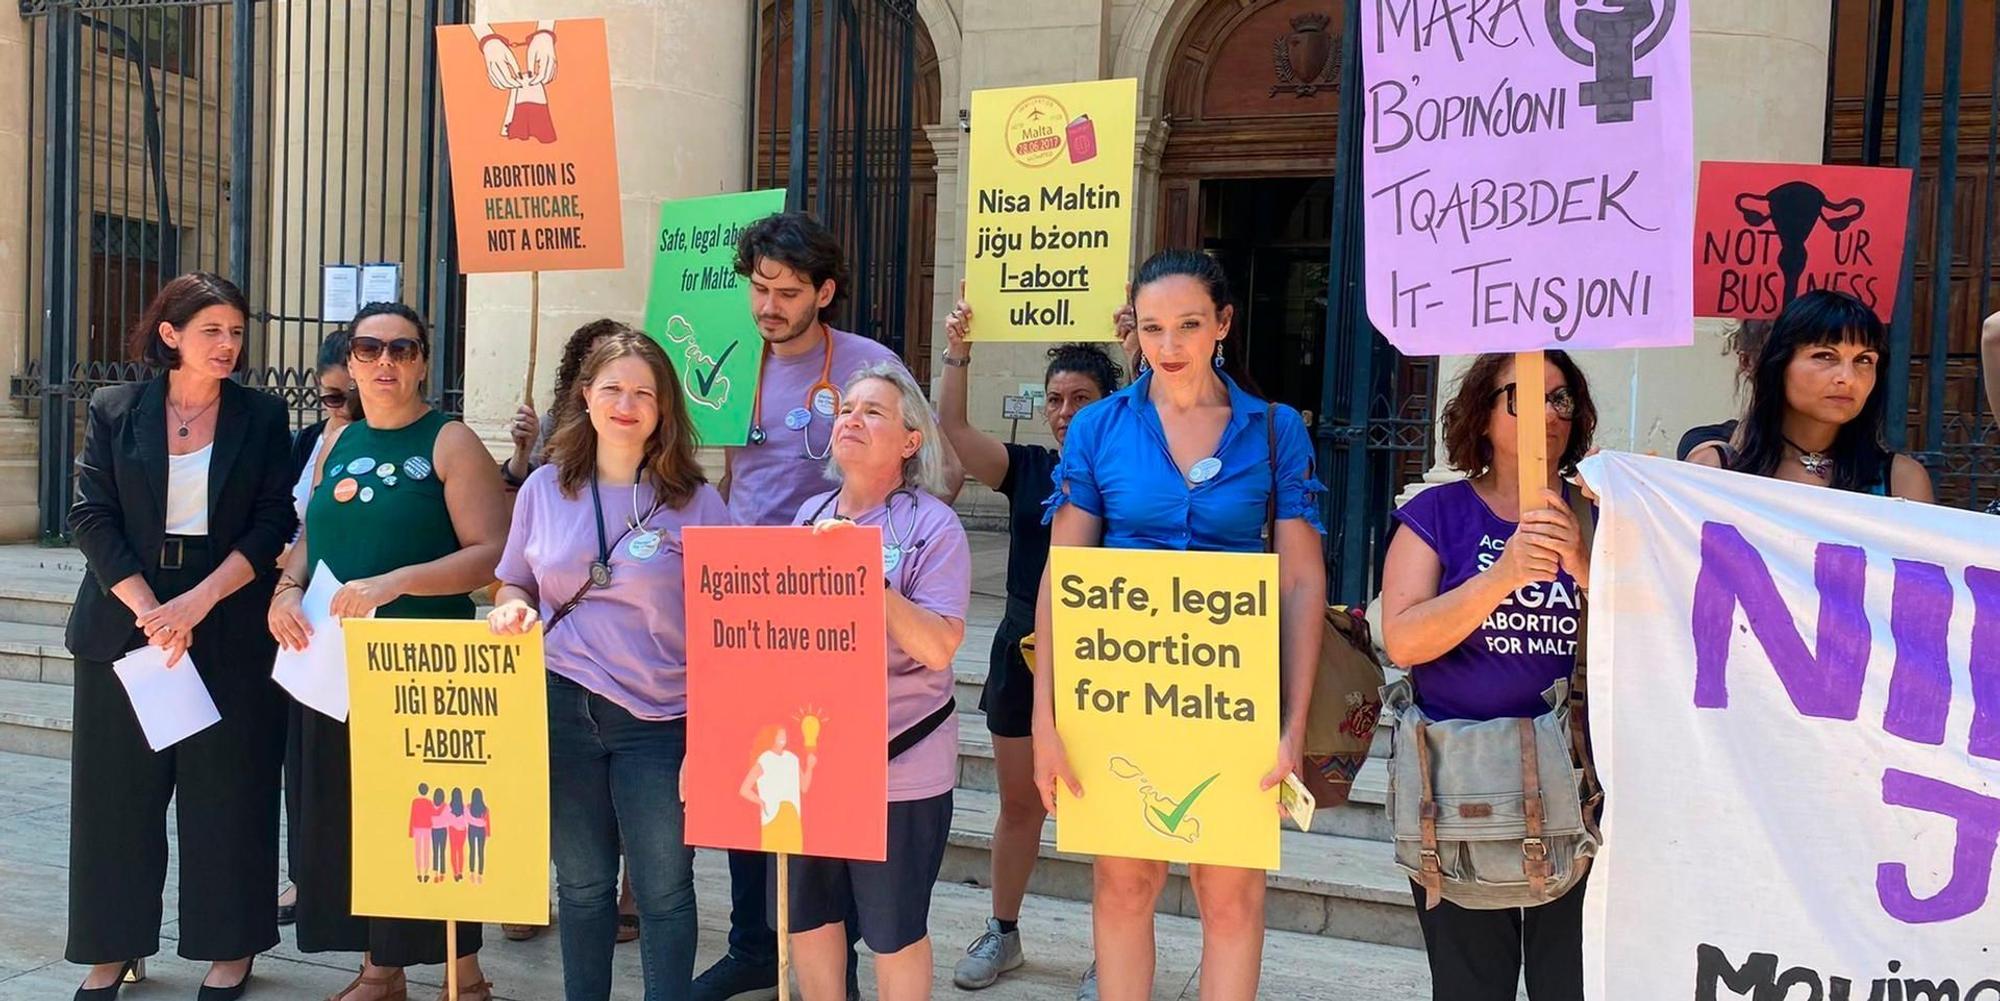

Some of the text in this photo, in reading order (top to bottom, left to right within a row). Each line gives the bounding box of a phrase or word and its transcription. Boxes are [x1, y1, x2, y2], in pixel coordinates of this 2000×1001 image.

[1022, 125, 1054, 140] Malta
[483, 162, 576, 188] ABORTION IS
[485, 195, 584, 220] HEALTHCARE,
[979, 183, 1120, 214] Nisa Maltin
[1371, 169, 1661, 244] TQABBDEK
[487, 226, 587, 252] NOT A CRIME.
[660, 227, 688, 253] Safe,
[691, 223, 722, 255] legal
[975, 225, 1109, 258] jiġu bżonn
[1704, 229, 1873, 266] NOT UR
[681, 265, 738, 291] for Malta.
[1000, 262, 1089, 290] l-abort
[1010, 299, 1075, 326] ukoll.
[700, 565, 867, 601] Against abortion?
[1061, 574, 1267, 625] Safe, legal
[713, 619, 856, 651] Don't have one!
[1482, 612, 1578, 635] ABORTIO
[367, 642, 521, 674] KULĦADD JISTA'
[1075, 628, 1240, 668] abortion
[1484, 636, 1579, 656] FOR MALT
[395, 678, 498, 716] JIĠI BŻONN
[1075, 678, 1255, 722] for Malta
[405, 727, 492, 762] L-ABORT.
